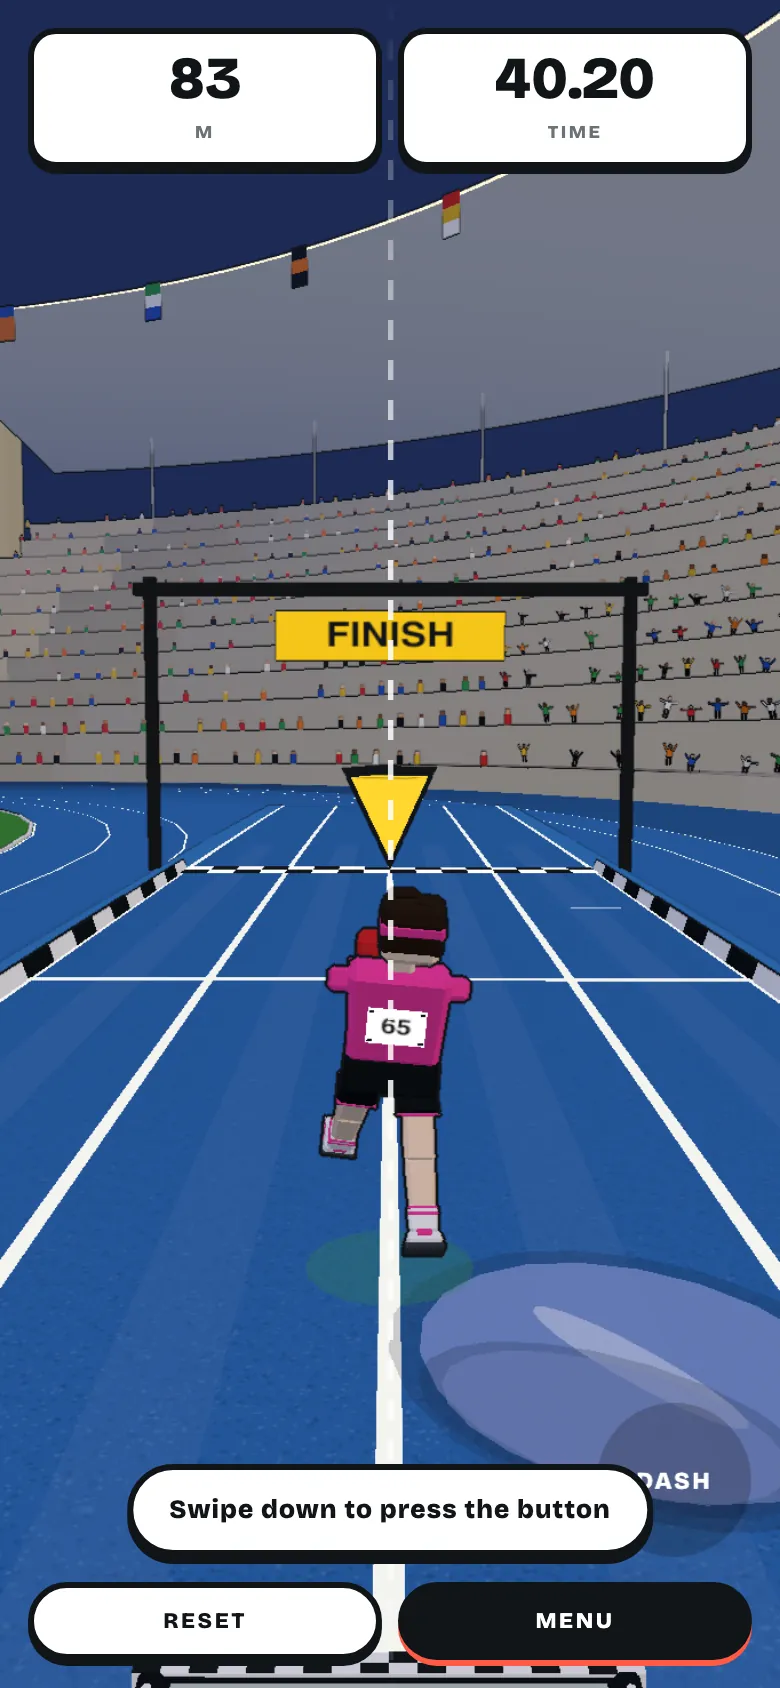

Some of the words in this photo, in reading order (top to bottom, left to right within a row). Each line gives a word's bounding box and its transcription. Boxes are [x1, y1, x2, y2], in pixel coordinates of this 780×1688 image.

[171, 58, 240, 99] 83
[496, 58, 653, 99] 40.20
[195, 125, 212, 139] M
[547, 125, 600, 139] TIME
[327, 621, 453, 648] FINISH
[381, 1018, 411, 1036] 65
[170, 1498, 252, 1522] Swipe
[262, 1499, 335, 1518] down
[345, 1501, 371, 1518] to
[381, 1504, 456, 1522] press
[465, 1499, 508, 1518] the
[519, 1499, 608, 1518] button
[164, 1612, 245, 1629] RESET
[536, 1612, 612, 1629] MENU
